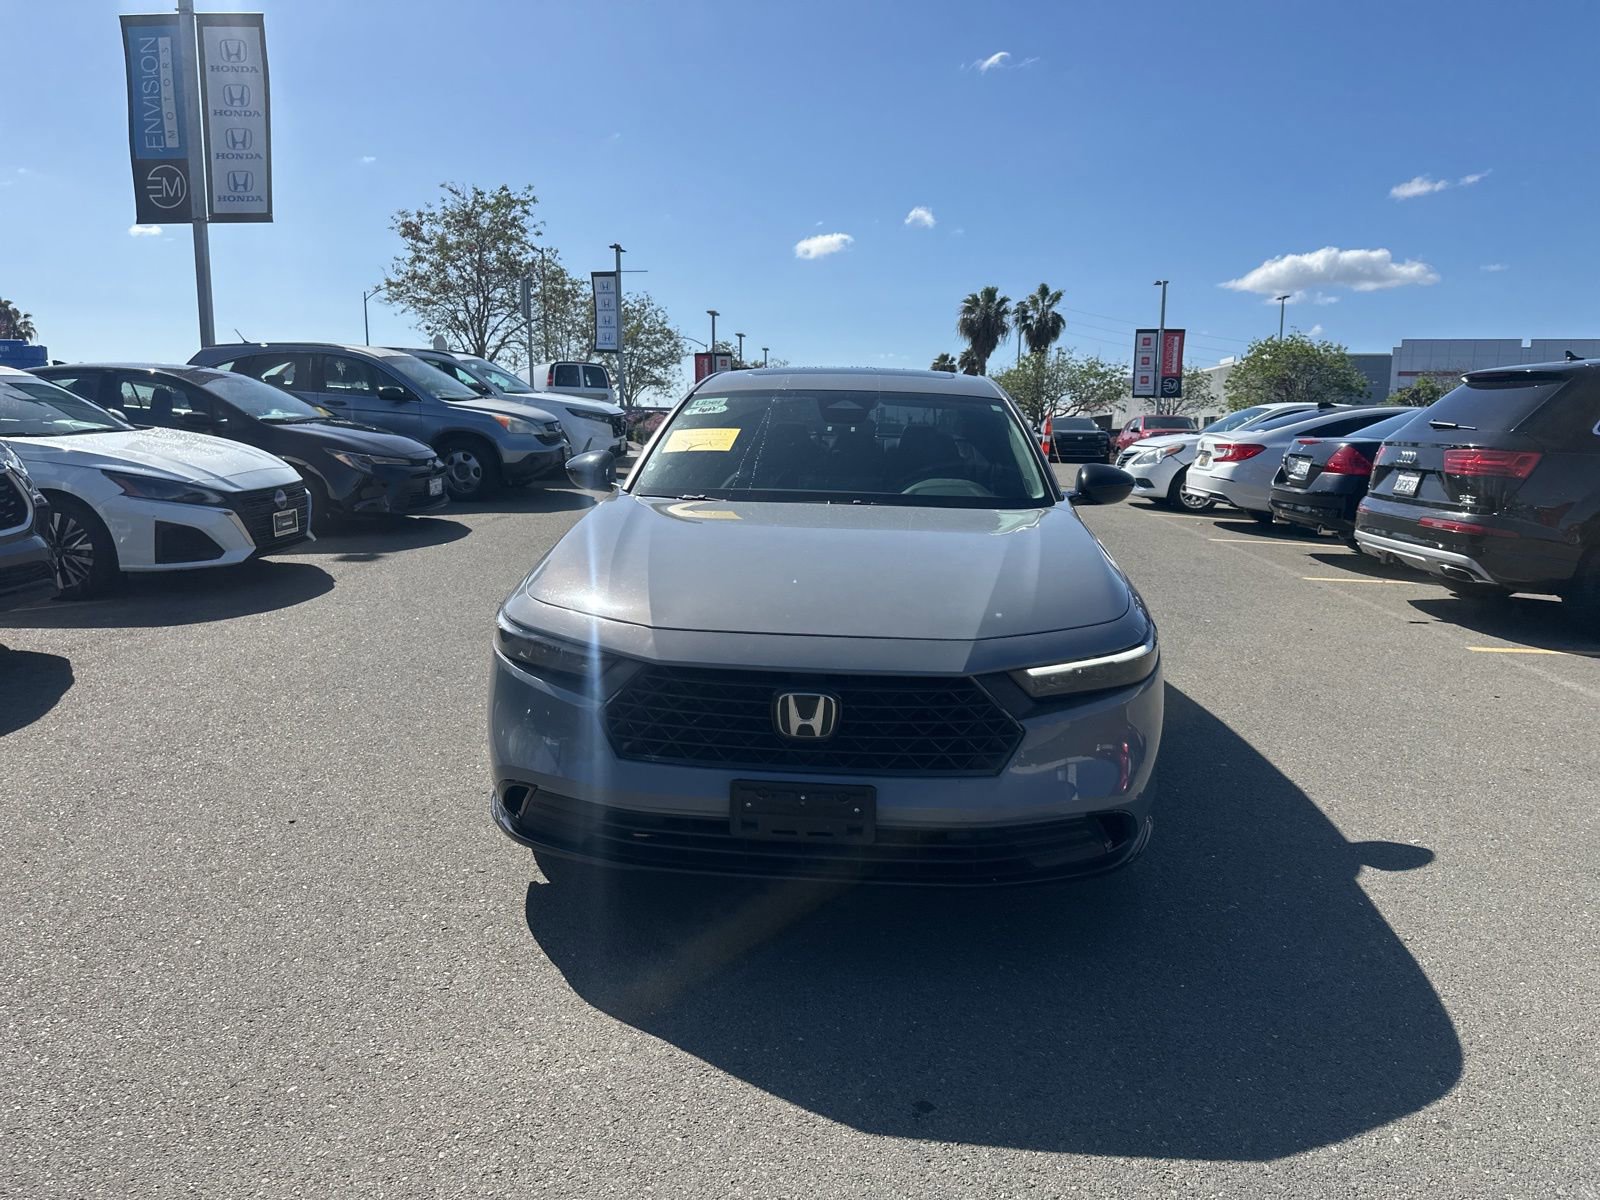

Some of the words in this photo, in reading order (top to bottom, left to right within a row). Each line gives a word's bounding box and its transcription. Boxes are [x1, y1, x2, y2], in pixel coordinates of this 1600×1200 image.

[210, 65, 260, 74] HONDA
[139, 37, 164, 150] ENVISION
[162, 47, 177, 139] MOTORS
[213, 109, 262, 118] HONDA
[215, 152, 263, 160] HONDA
[217, 195, 264, 203] HONDA
